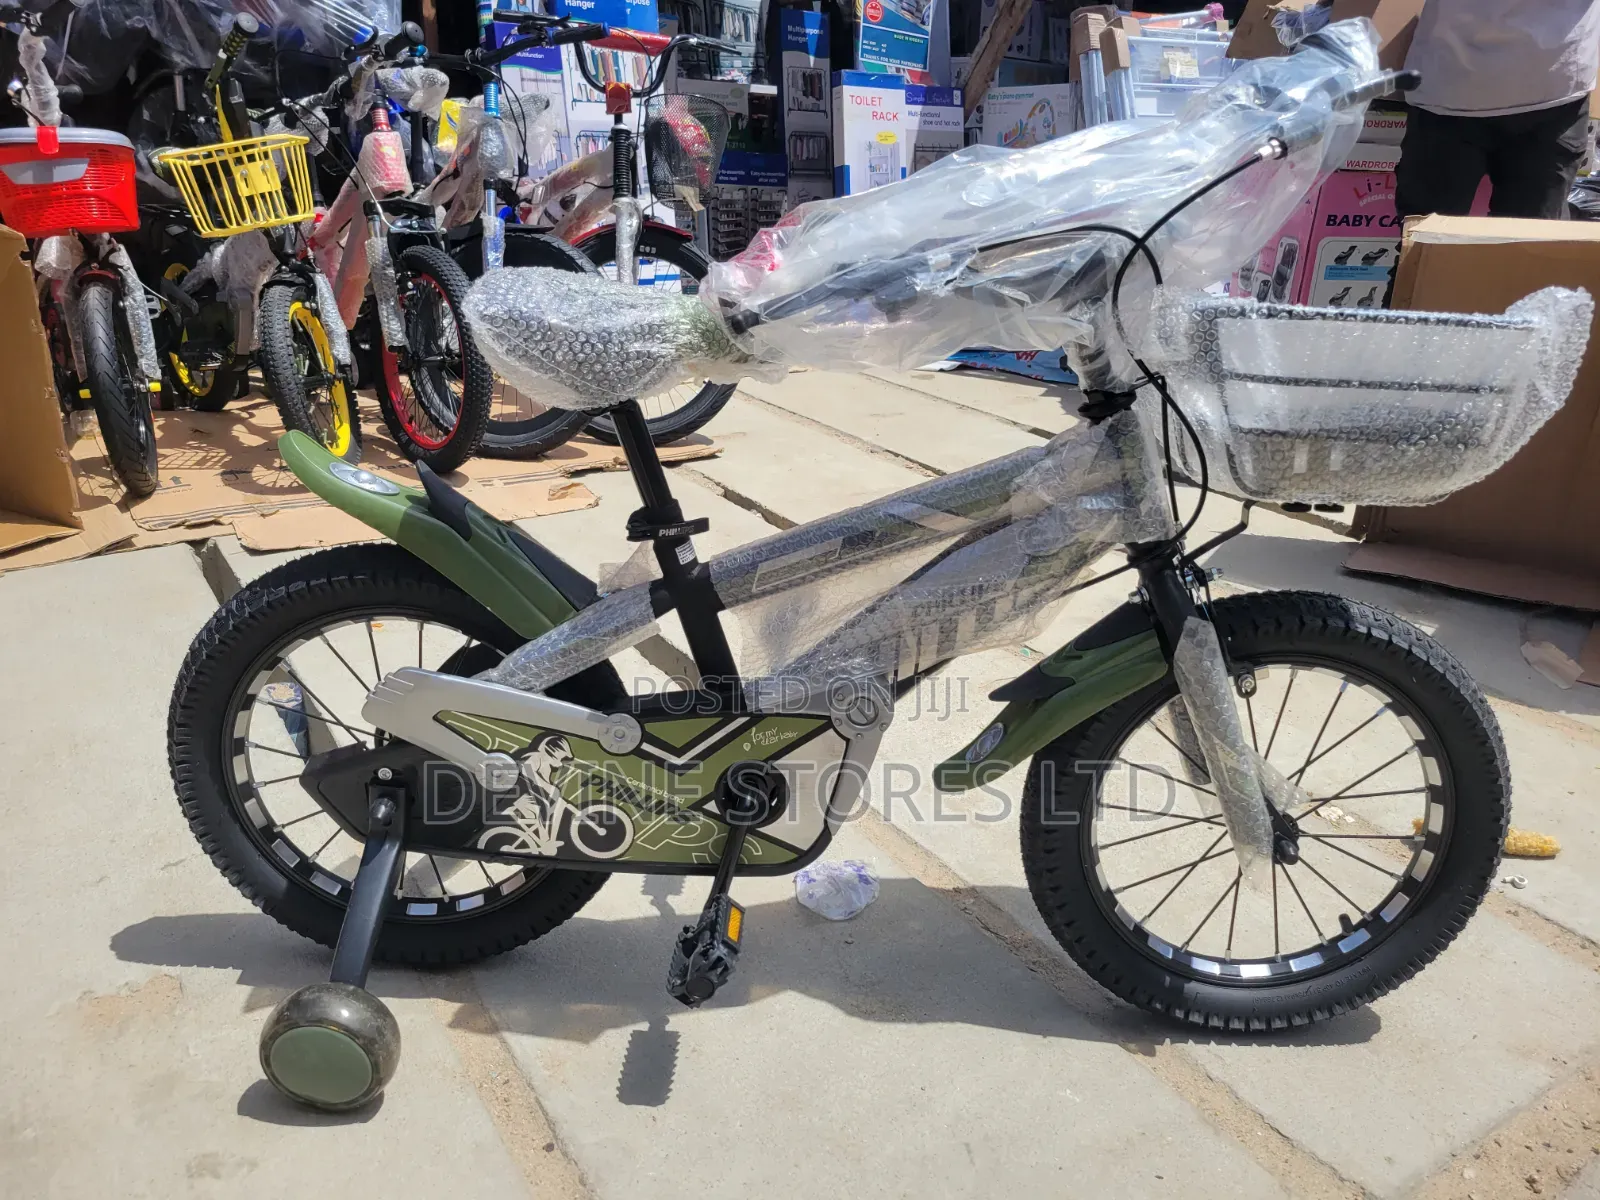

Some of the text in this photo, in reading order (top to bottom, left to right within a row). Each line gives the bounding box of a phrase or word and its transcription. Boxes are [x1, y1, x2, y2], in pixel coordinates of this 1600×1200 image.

[565, 0, 596, 10] Hanger
[787, 25, 824, 35] Multipurpose
[787, 34, 809, 44] Hanger
[849, 95, 883, 107] TOILET
[906, 92, 926, 103] Simple
[872, 111, 899, 122] RACK
[1364, 120, 1408, 129] WARDRO
[1346, 160, 1398, 169] WARDROB
[1359, 194, 1386, 207] SPECIAL
[1325, 214, 1376, 227] BABY
[658, 526, 695, 537] PHILLIPS
[626, 776, 685, 804] Centennial brand
